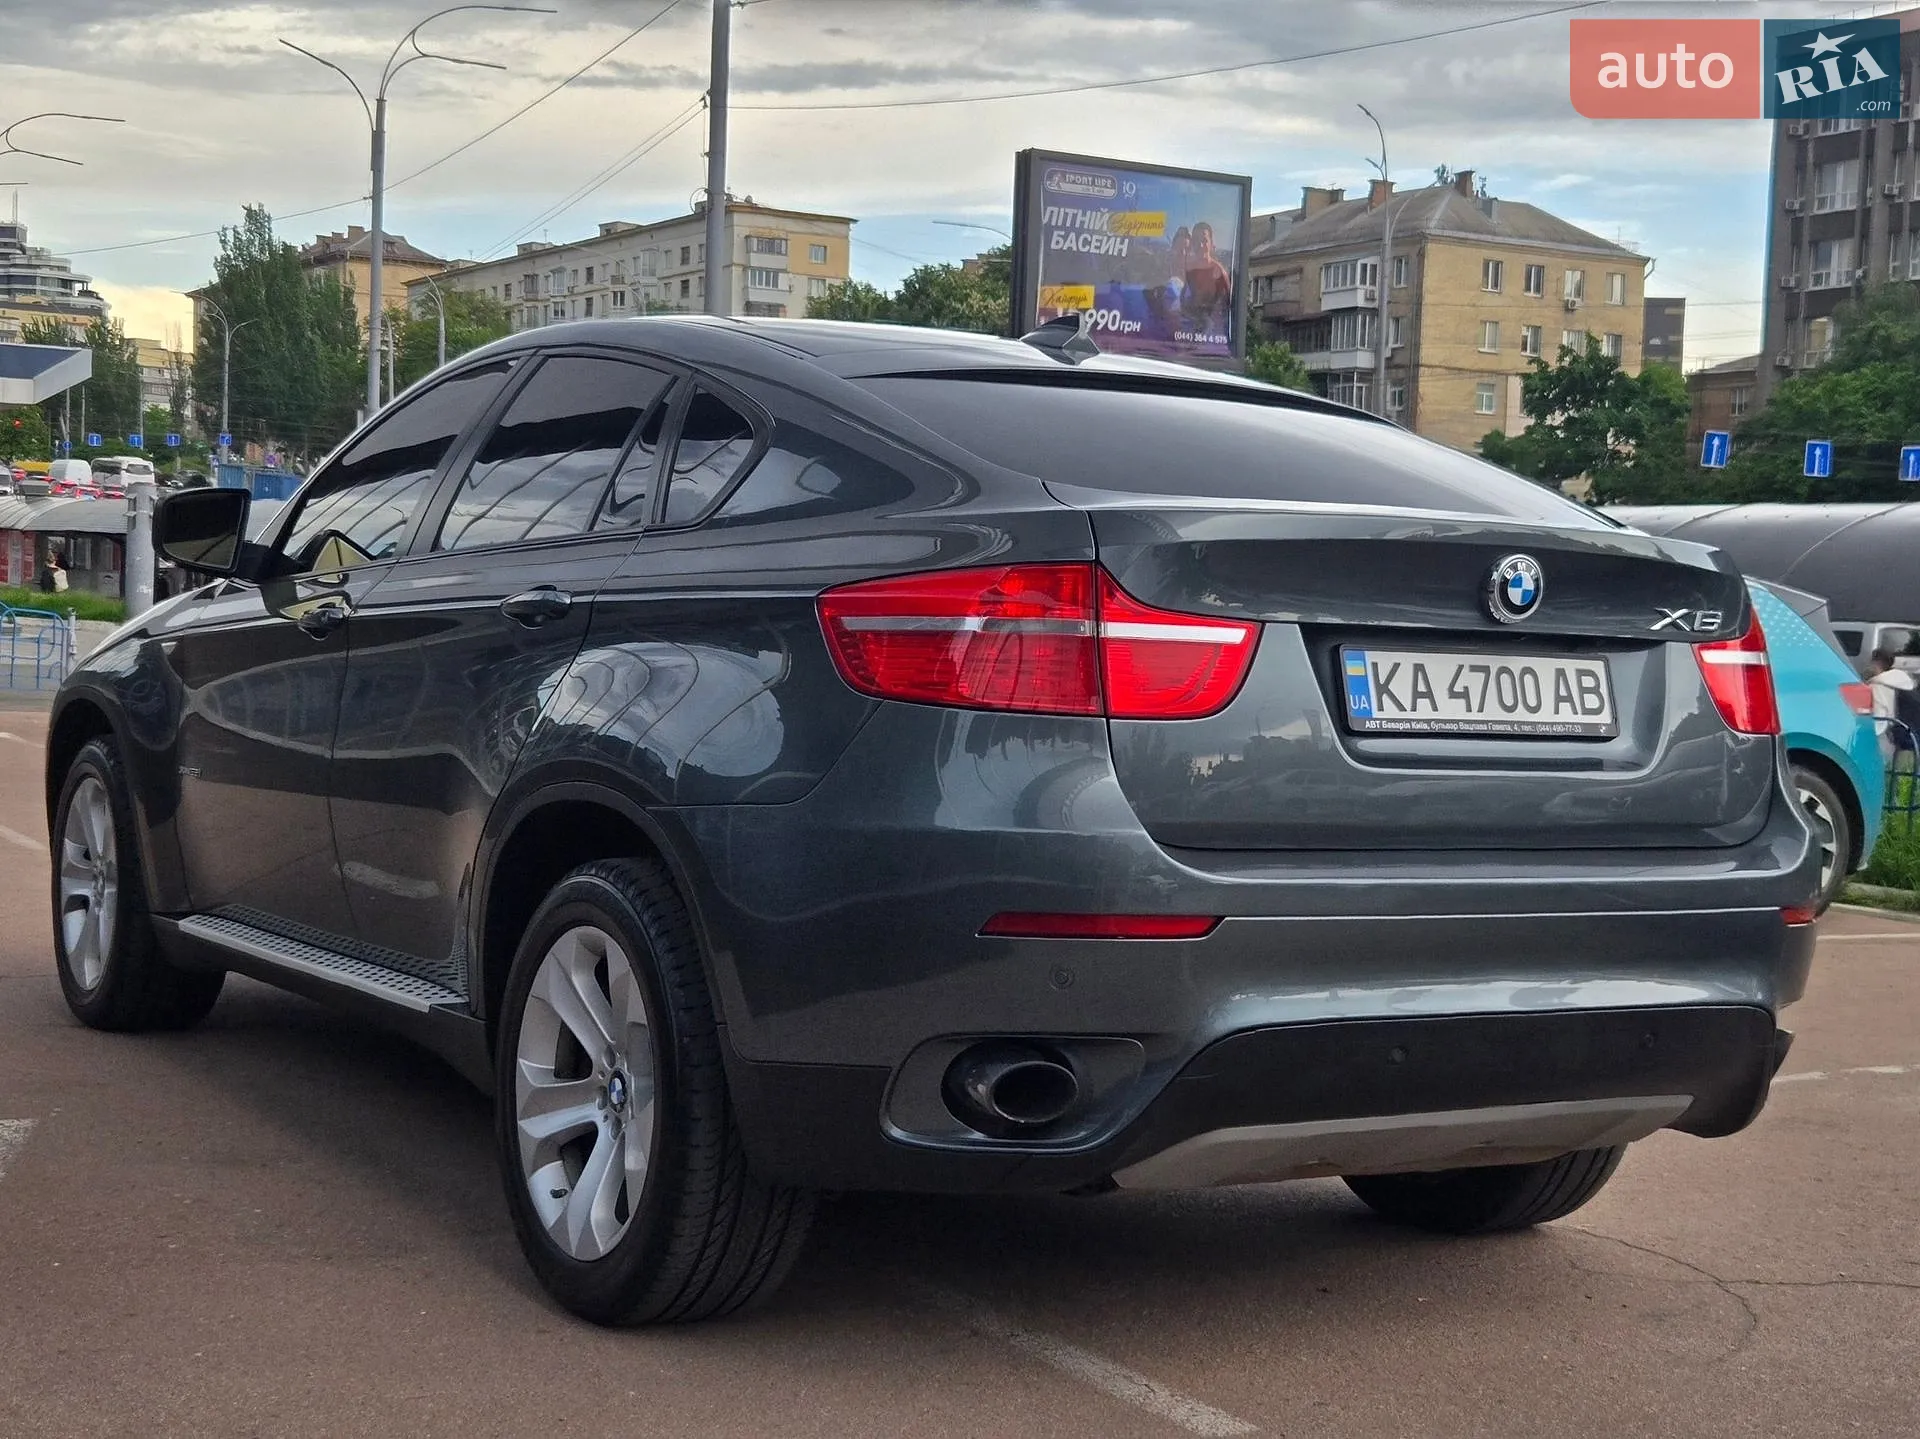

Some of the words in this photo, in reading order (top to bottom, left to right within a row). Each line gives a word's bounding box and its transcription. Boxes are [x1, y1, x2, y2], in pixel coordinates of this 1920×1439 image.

[1042, 206, 1110, 231] ЛІТНІЙ
[1050, 231, 1129, 257] БАСЕЙН
[1120, 320, 1141, 334] грн
[1649, 608, 1723, 632] X6
[1371, 661, 1439, 713] KA
[1448, 664, 1542, 714] 4700
[1553, 667, 1605, 716] AB
[1350, 694, 1370, 710] UA
[1365, 720, 1380, 729] АВТ
